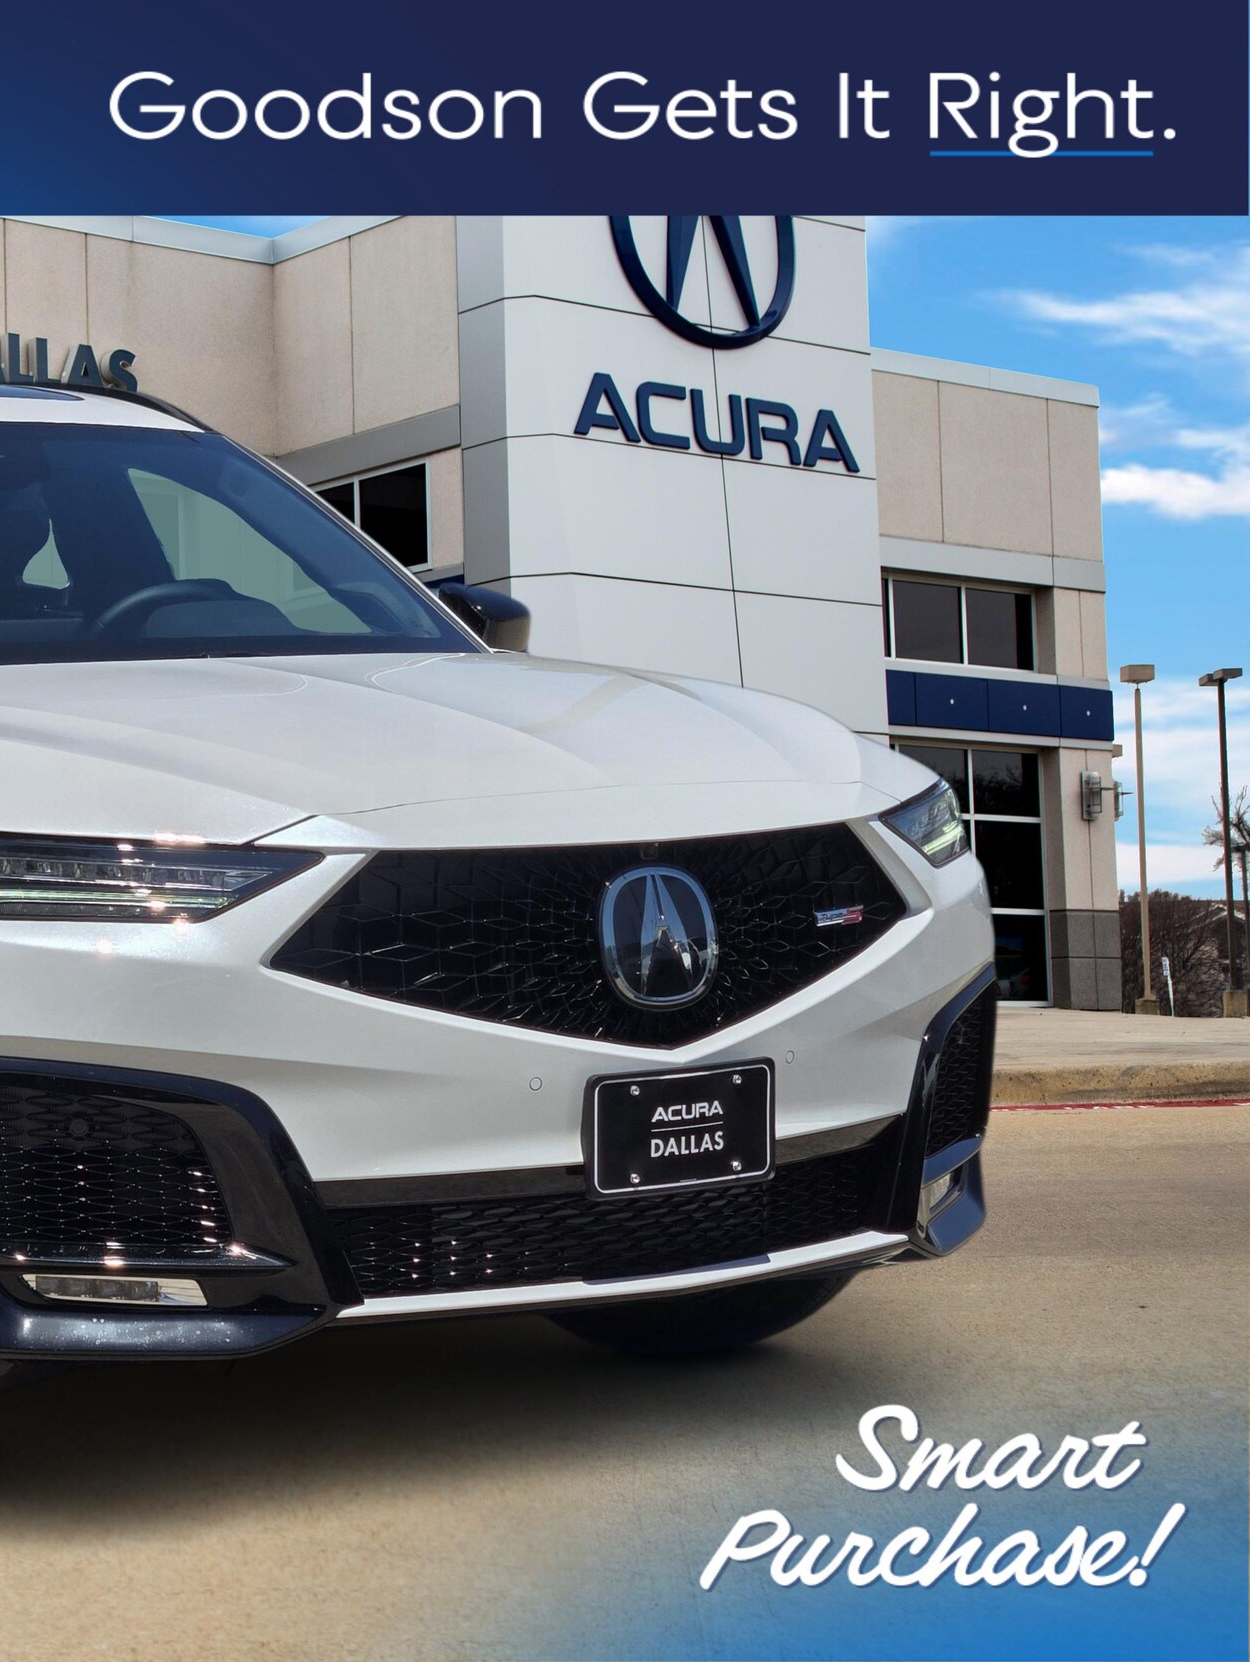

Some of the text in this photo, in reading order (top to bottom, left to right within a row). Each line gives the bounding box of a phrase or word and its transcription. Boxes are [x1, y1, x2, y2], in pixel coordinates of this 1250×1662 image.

[573, 372, 860, 473] ACURA
[651, 1100, 724, 1123] ACURA
[650, 1131, 725, 1158] DALLAS
